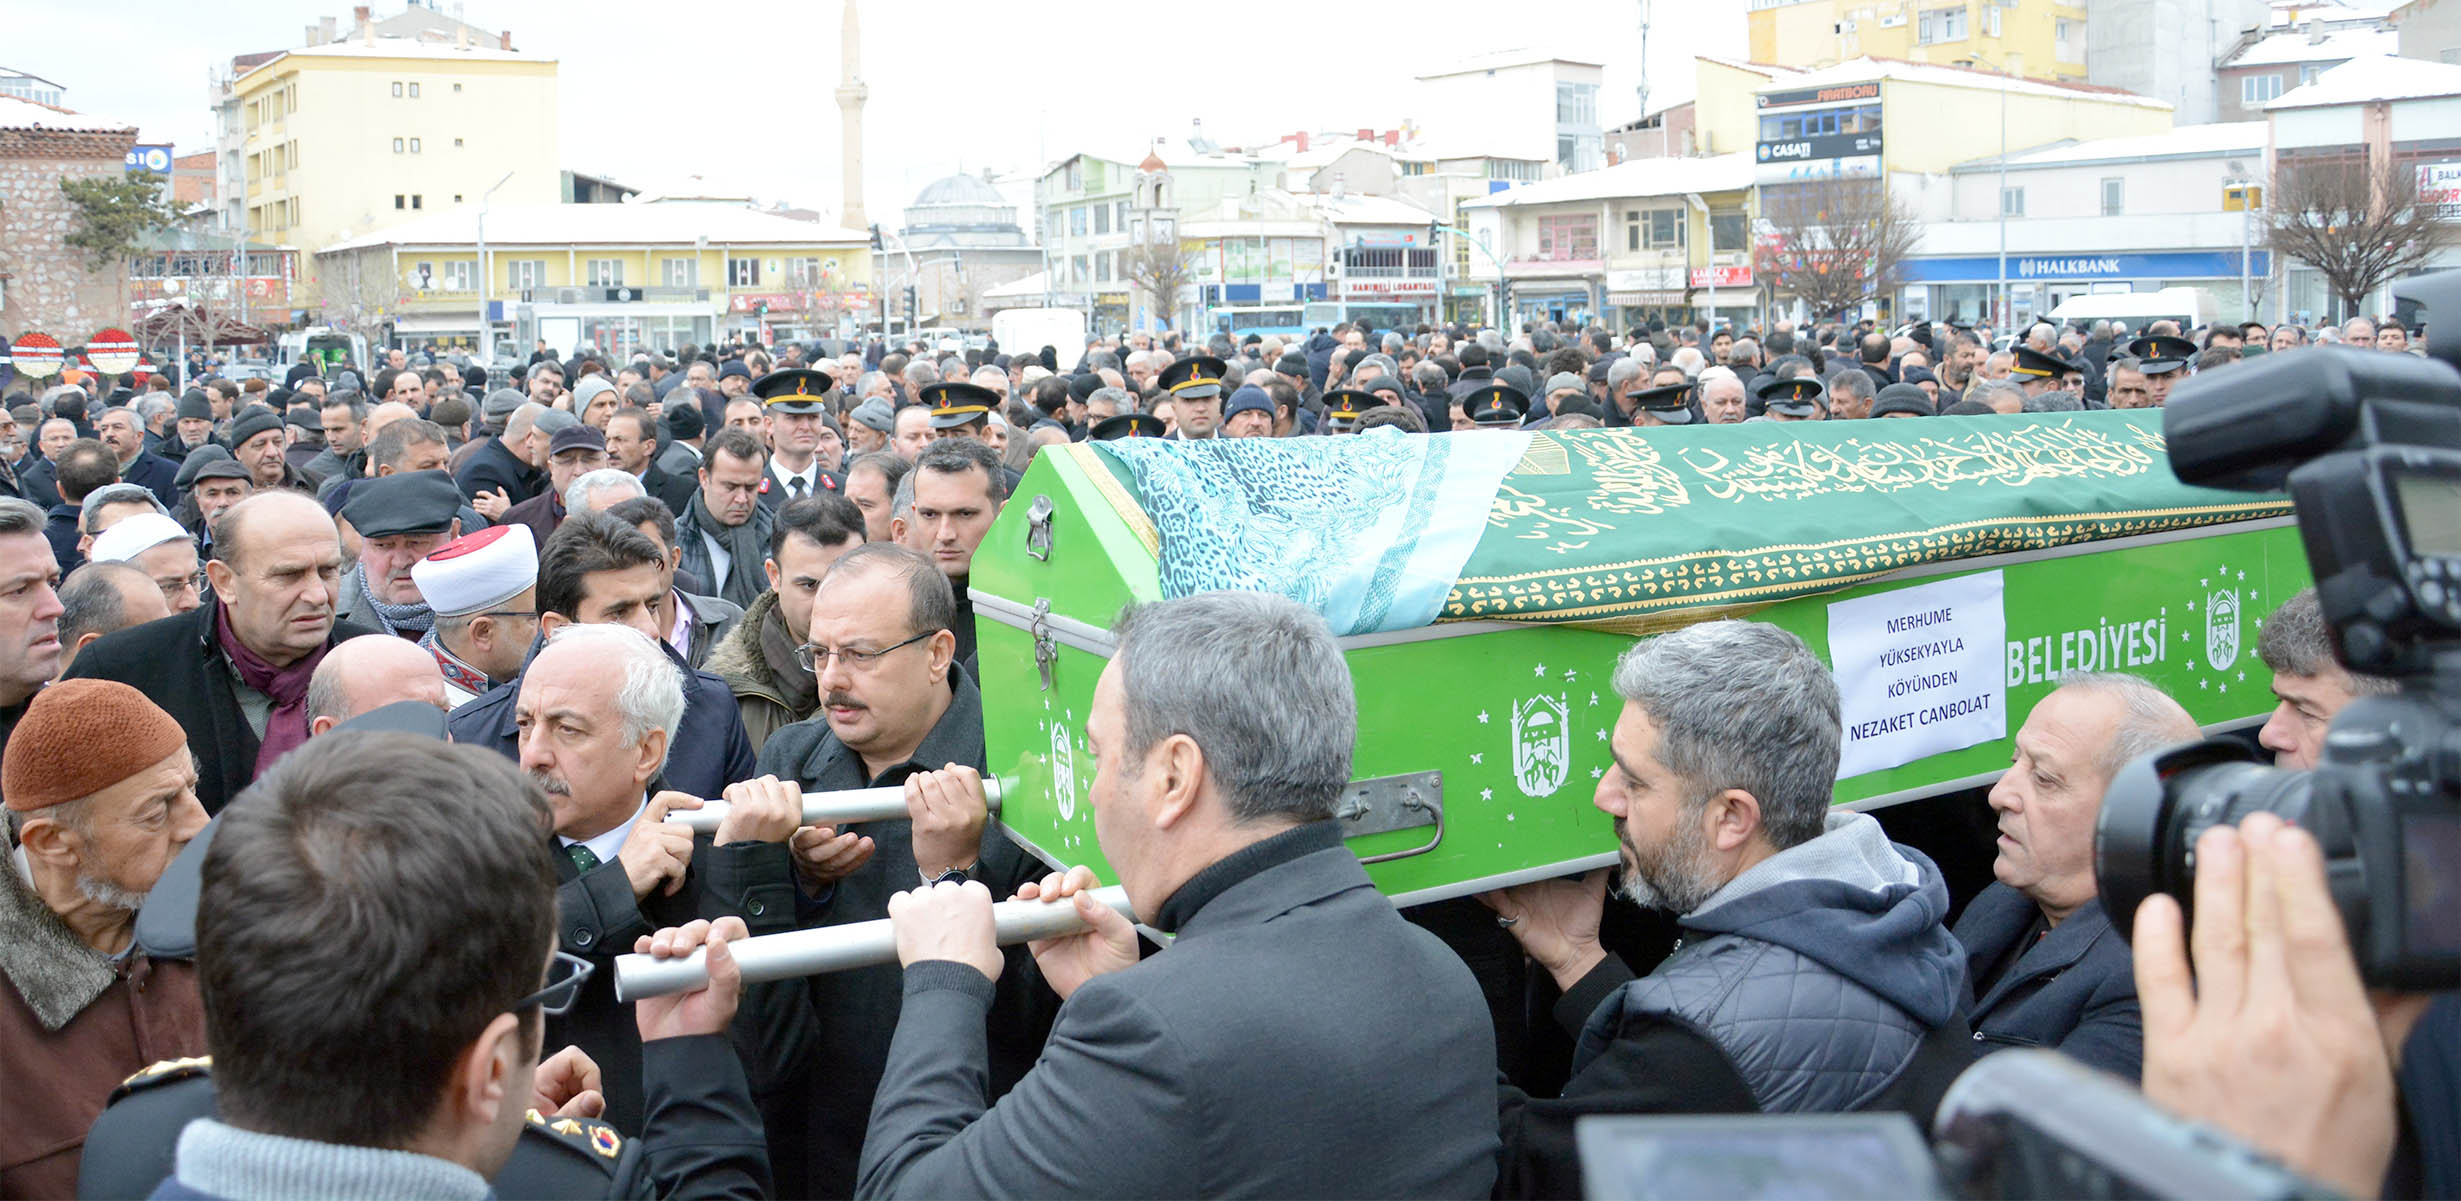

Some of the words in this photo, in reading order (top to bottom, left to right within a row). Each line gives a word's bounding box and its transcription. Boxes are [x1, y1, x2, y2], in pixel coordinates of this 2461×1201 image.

[2036, 259, 2120, 274] HALKBANK
[1887, 607, 1953, 634] MERHUME
[1880, 637, 1964, 668] YÜKSEKYAYLA
[2007, 607, 2167, 688] BELEDİYESİ
[1888, 670, 1958, 699] KÖYÜNDEN
[1850, 712, 1915, 741] NEZAKET
[1919, 693, 1991, 726] CANBOLAT
